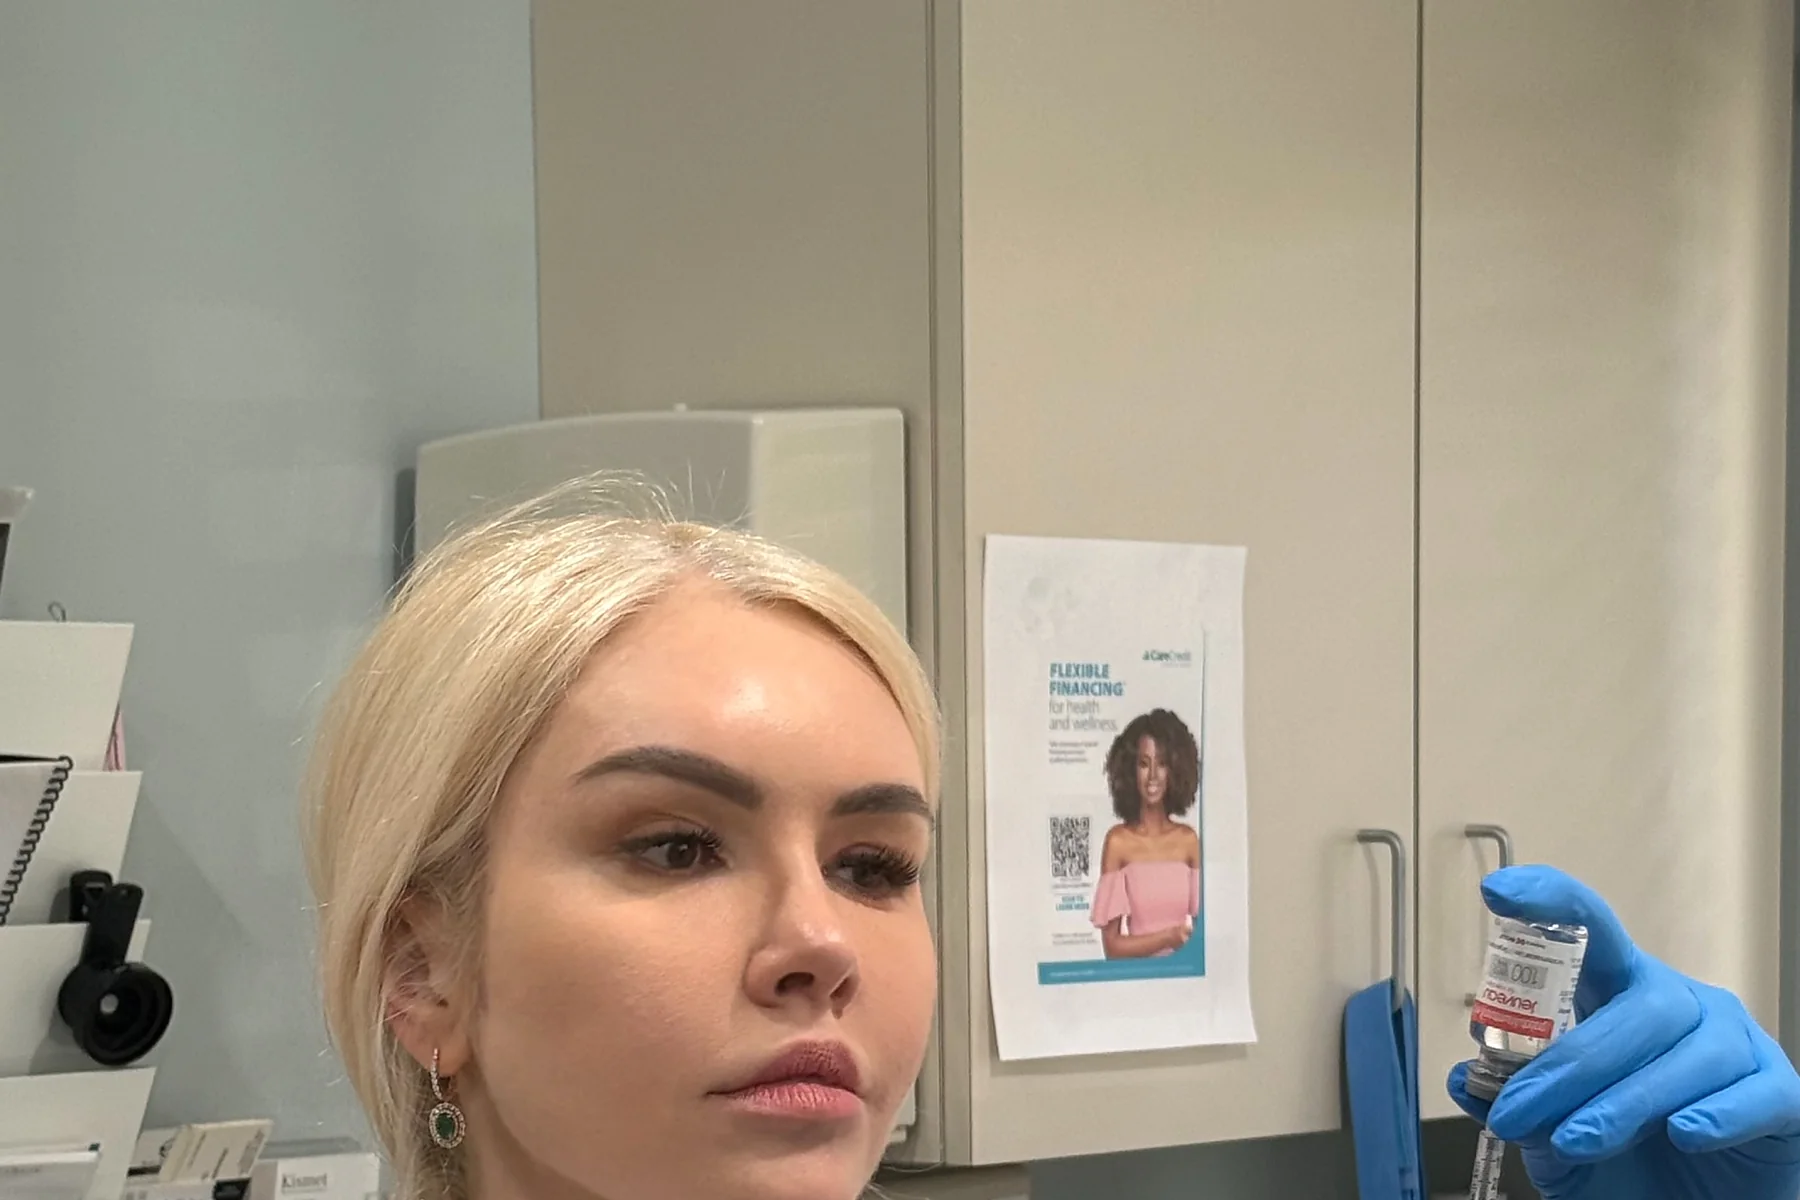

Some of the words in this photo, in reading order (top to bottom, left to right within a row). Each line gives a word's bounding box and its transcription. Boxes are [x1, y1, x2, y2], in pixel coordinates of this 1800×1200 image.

[1050, 663, 1109, 678] FLEXIBLE
[1049, 699, 1063, 713] for
[1066, 699, 1099, 714] health
[1049, 716, 1070, 730] and
[1511, 963, 1538, 985] 100
